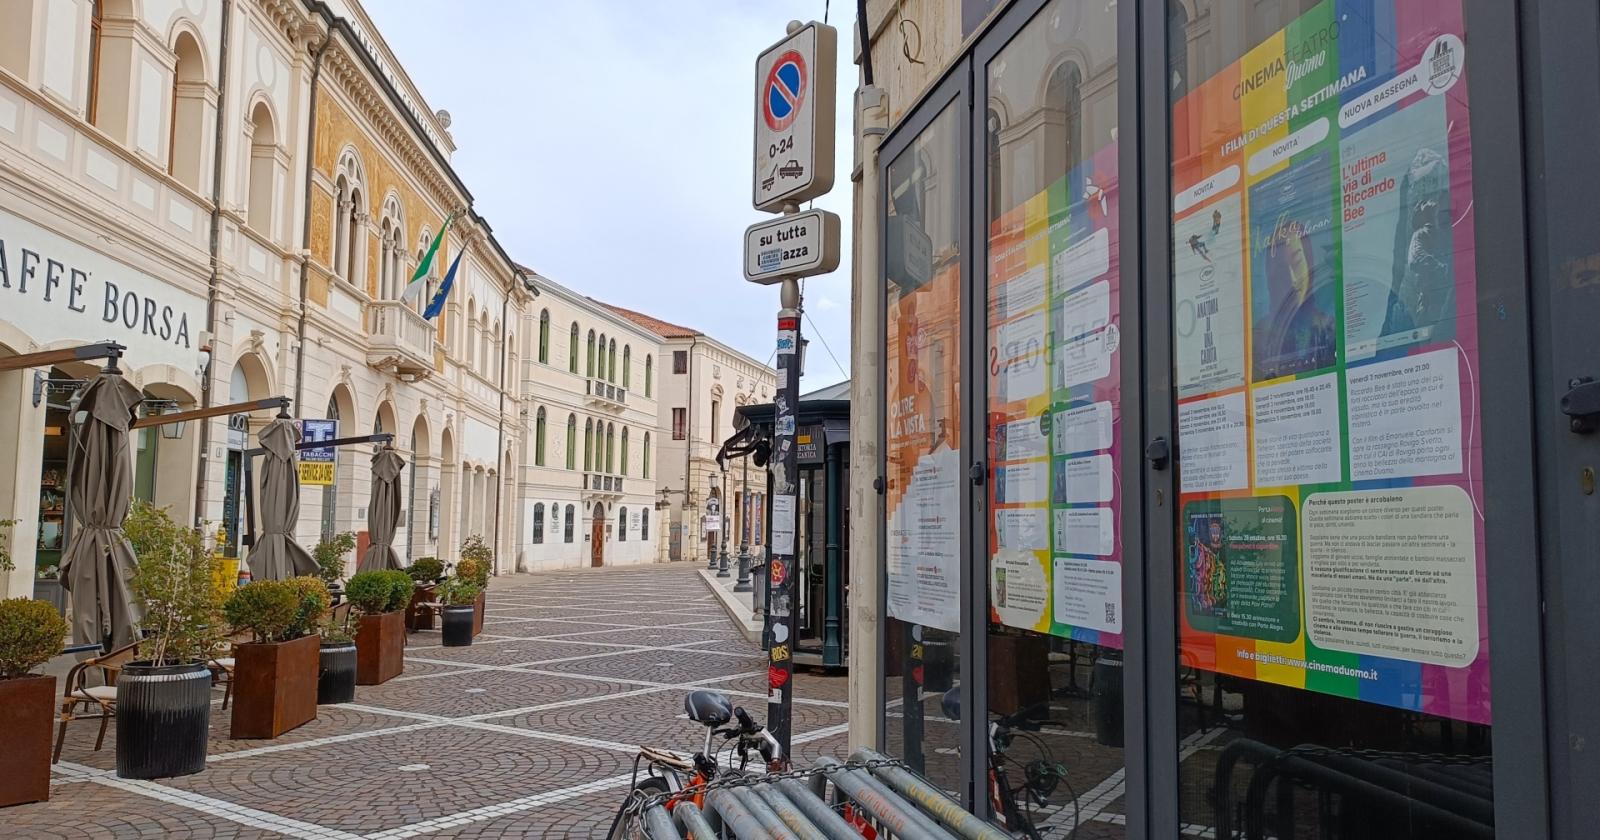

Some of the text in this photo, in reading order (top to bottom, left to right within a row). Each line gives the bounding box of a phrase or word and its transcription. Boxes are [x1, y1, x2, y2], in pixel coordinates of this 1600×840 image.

[1226, 136, 1248, 154] FILM
[1249, 129, 1259, 141] DI
[1260, 107, 1299, 137] QUESTA
[1300, 65, 1367, 113] SETTIMANA
[1344, 73, 1418, 120] NUOVA RASSEGNA
[769, 135, 794, 158] 0-24
[1343, 150, 1387, 180] L'ultima
[1343, 170, 1372, 194] via di
[1343, 176, 1395, 208] Riccardo
[1344, 205, 1365, 223] Bee
[760, 225, 806, 246] su tutta
[102, 281, 191, 349] BORSA
[772, 645, 788, 660] BDS
[1237, 650, 1249, 659] Info
[1255, 651, 1286, 665] biglietti:
[1286, 658, 1378, 681] www.cinemaduomo.it
